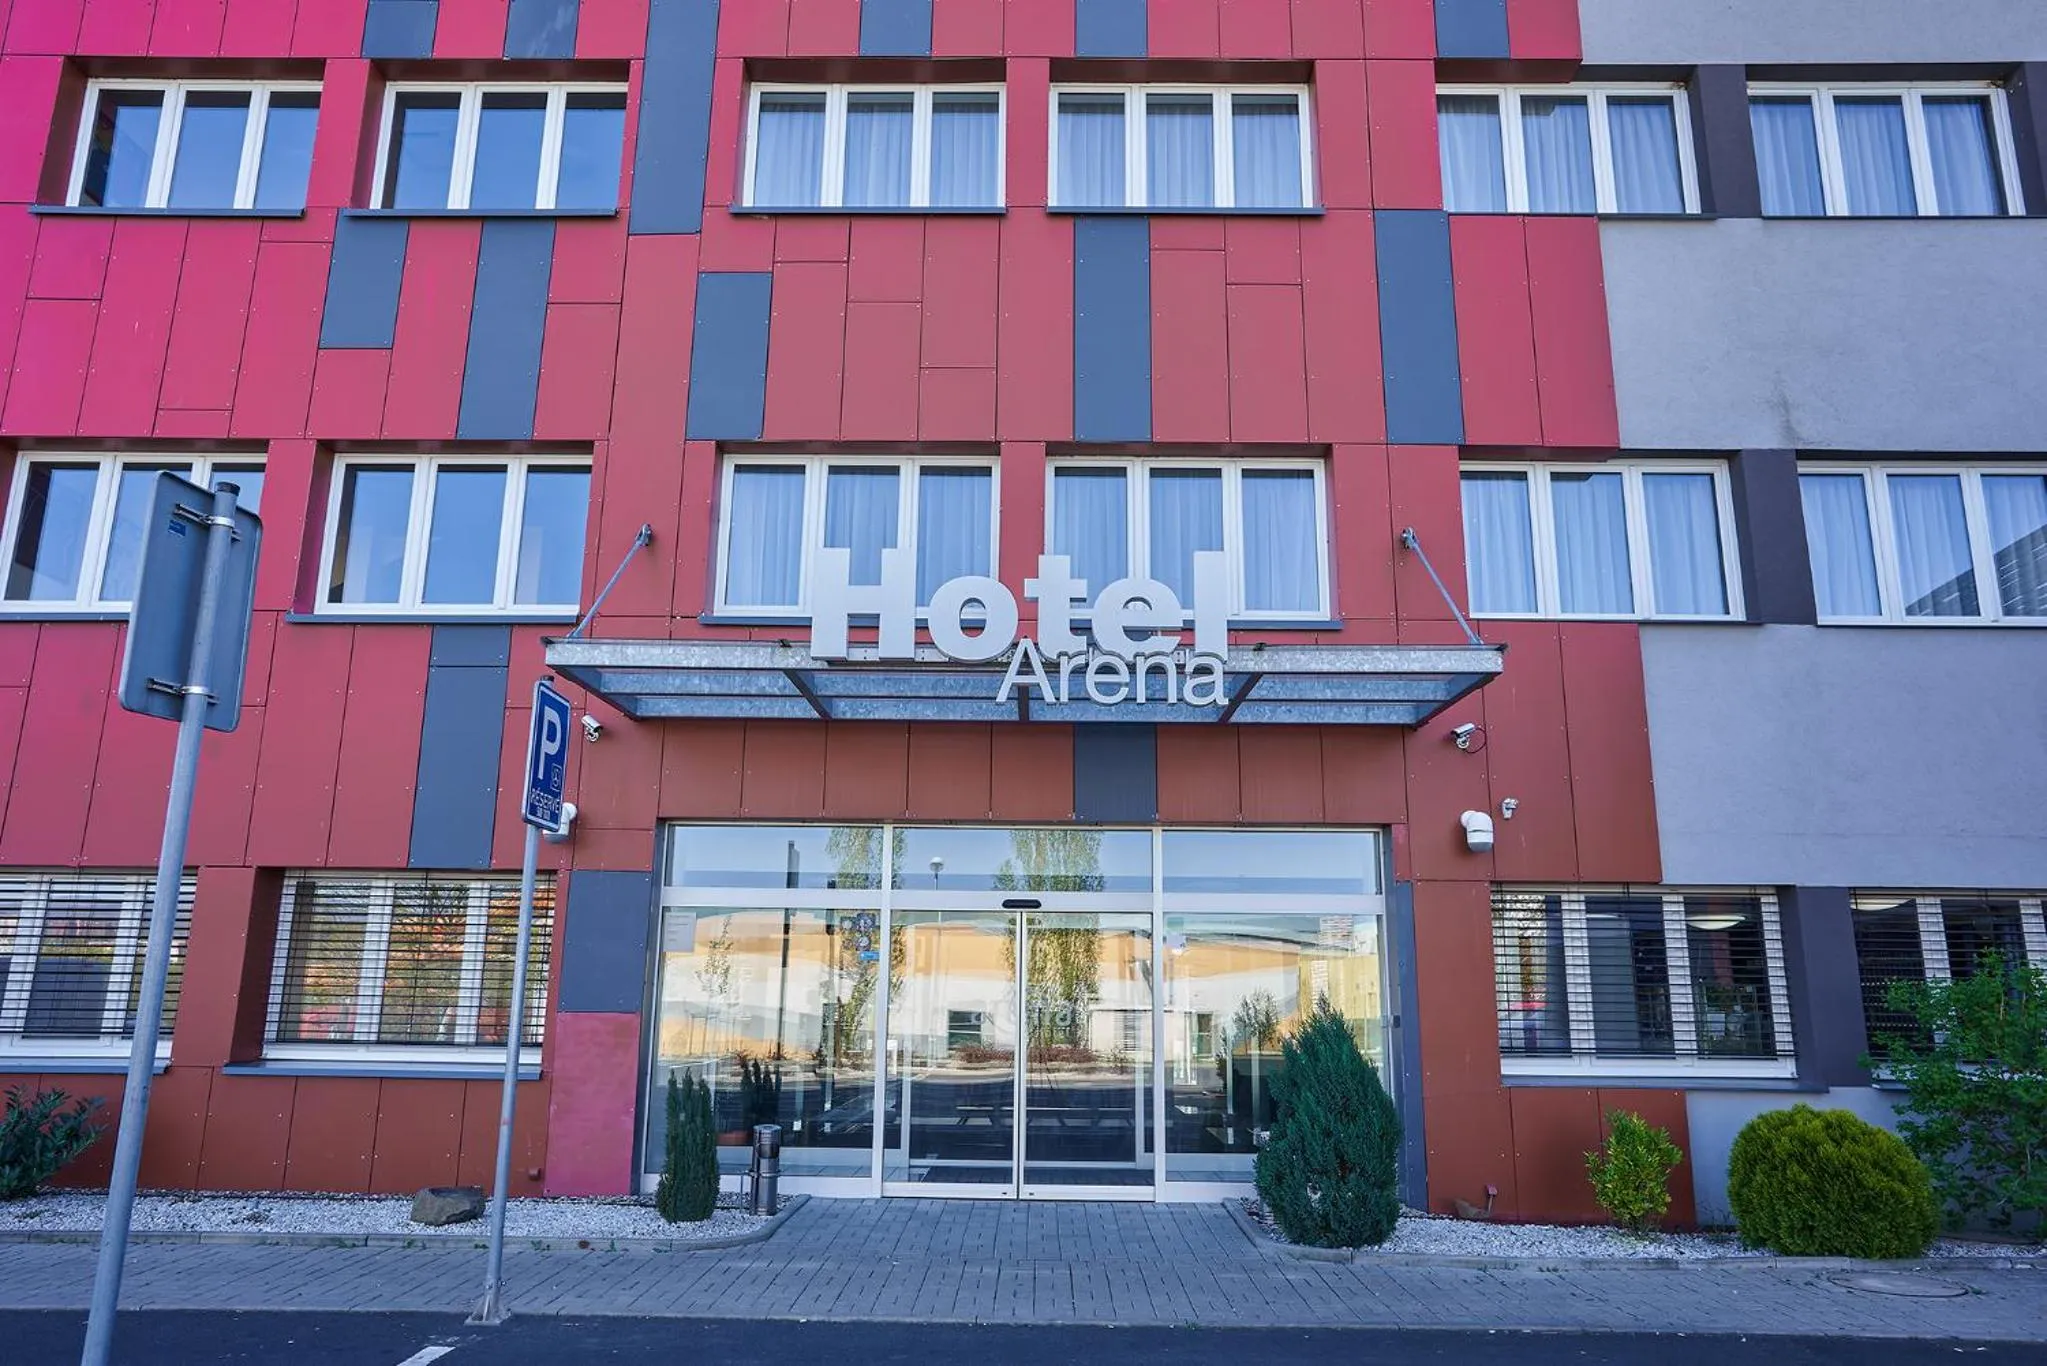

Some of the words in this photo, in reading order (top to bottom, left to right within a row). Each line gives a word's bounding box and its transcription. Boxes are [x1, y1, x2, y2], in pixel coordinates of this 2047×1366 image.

[811, 548, 1228, 661] Hotel
[996, 638, 1229, 705] Arena
[537, 706, 562, 780] P
